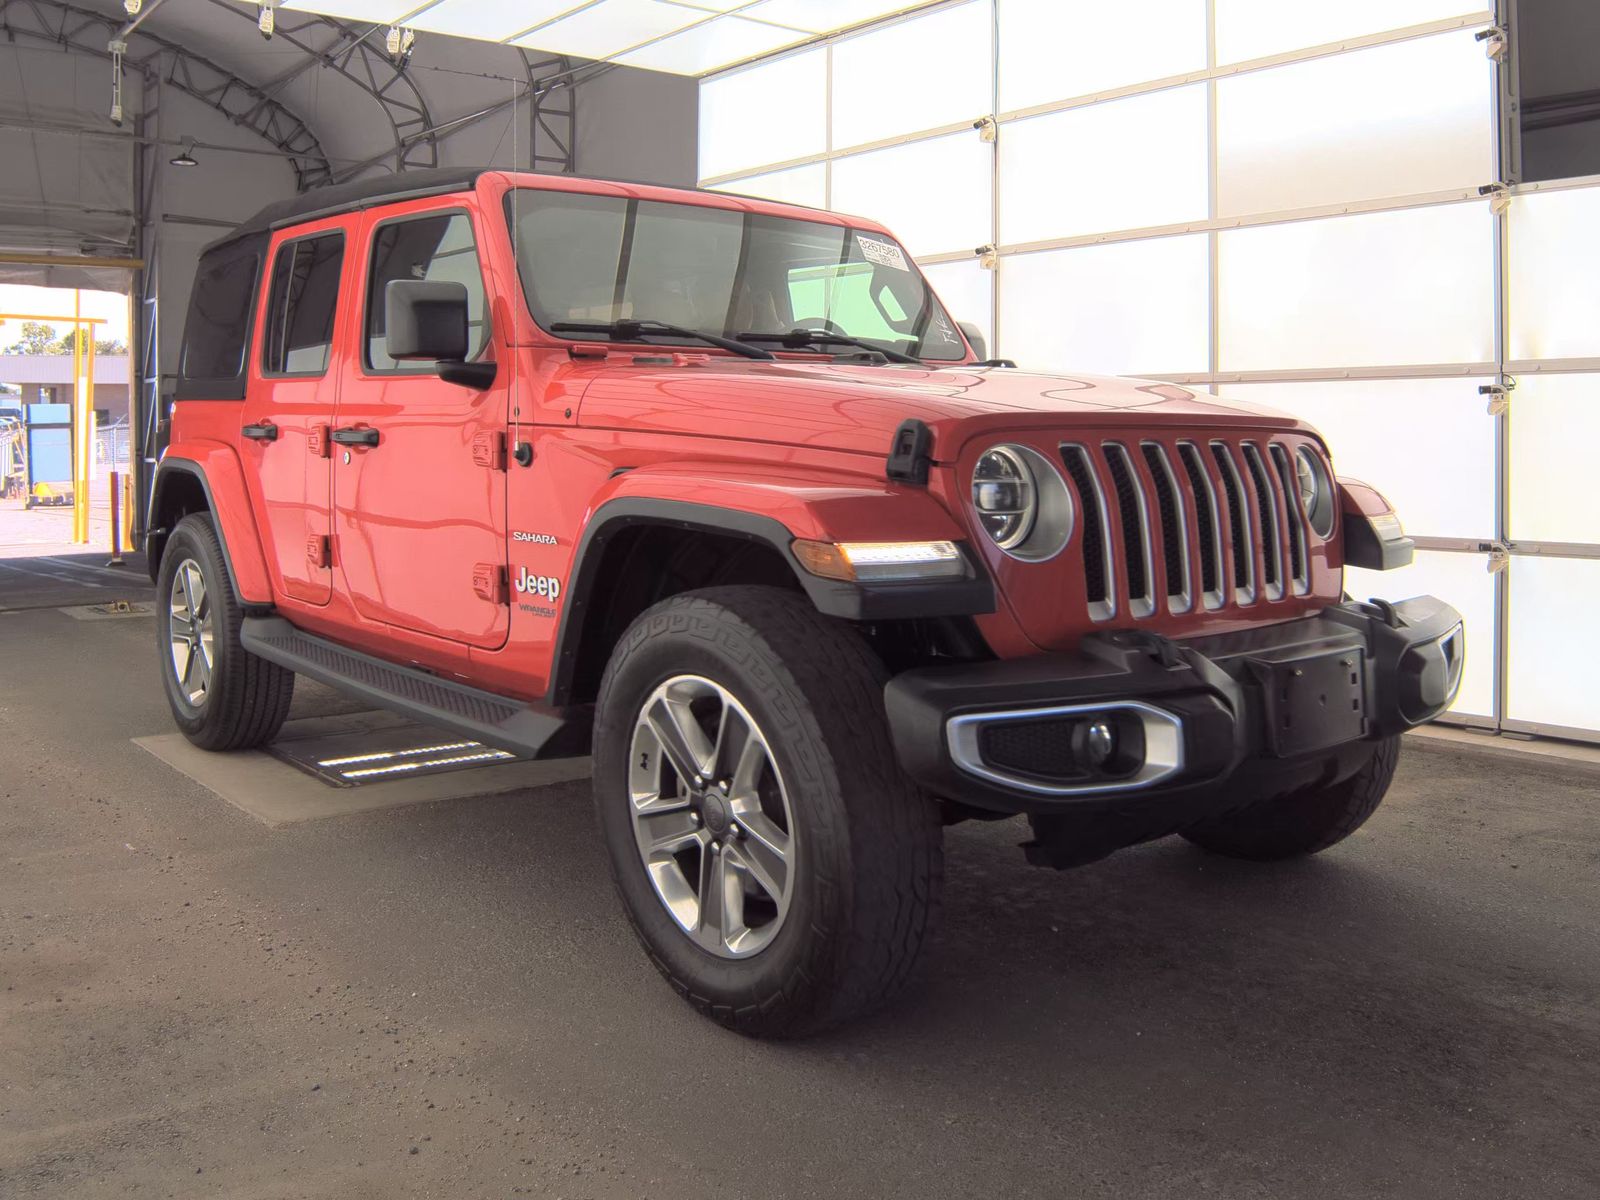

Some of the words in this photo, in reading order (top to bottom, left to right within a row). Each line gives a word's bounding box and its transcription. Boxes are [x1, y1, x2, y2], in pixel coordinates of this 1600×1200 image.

[859, 239, 899, 258] 3267580
[513, 531, 557, 544] SAHARA
[515, 566, 561, 602] Jeep
